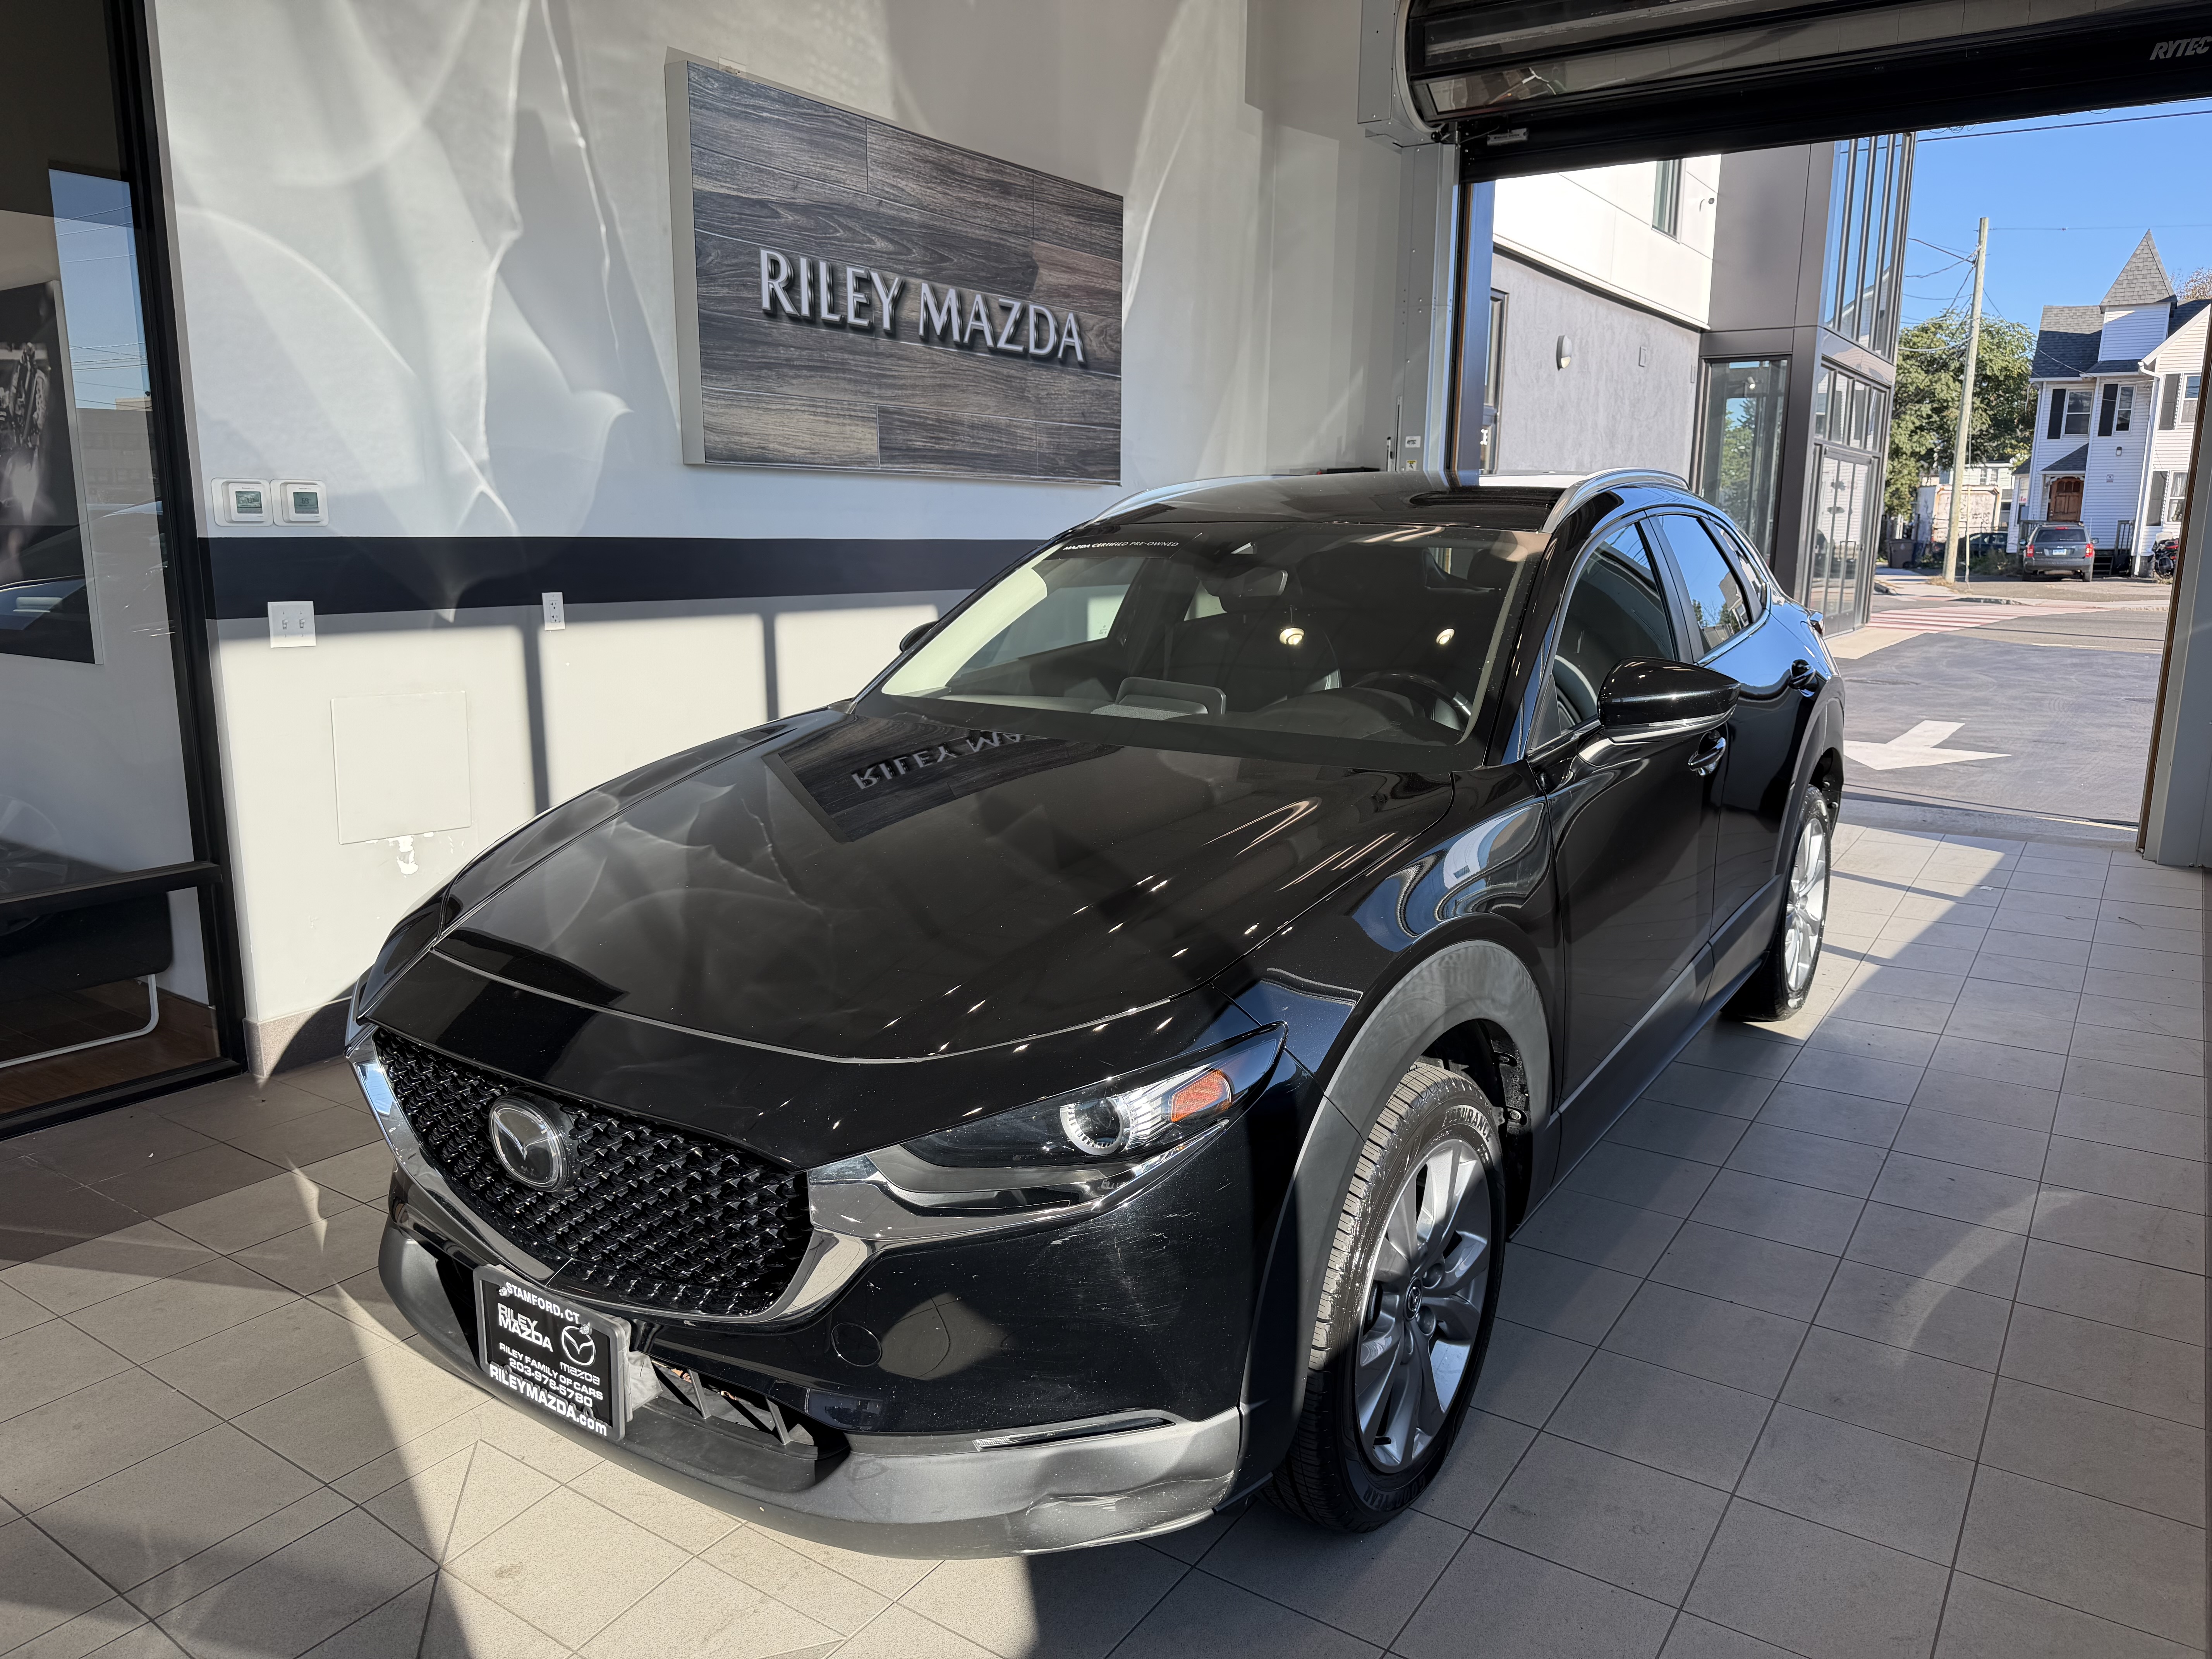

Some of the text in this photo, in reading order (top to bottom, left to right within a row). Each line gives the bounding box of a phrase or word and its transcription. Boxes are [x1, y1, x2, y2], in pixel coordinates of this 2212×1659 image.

[2149, 36, 2212, 60] RYTEC
[759, 248, 1085, 364] RILEY MAZDA
[498, 1302, 538, 1331] RILEY
[505, 1282, 581, 1324] STAMFORD, CT
[498, 1314, 553, 1352] MAZDA
[499, 1342, 603, 1400] RILEY FAMILY OF CARS
[560, 1361, 600, 1386] mazda
[489, 1363, 607, 1436] RILEYMAZDA.com
